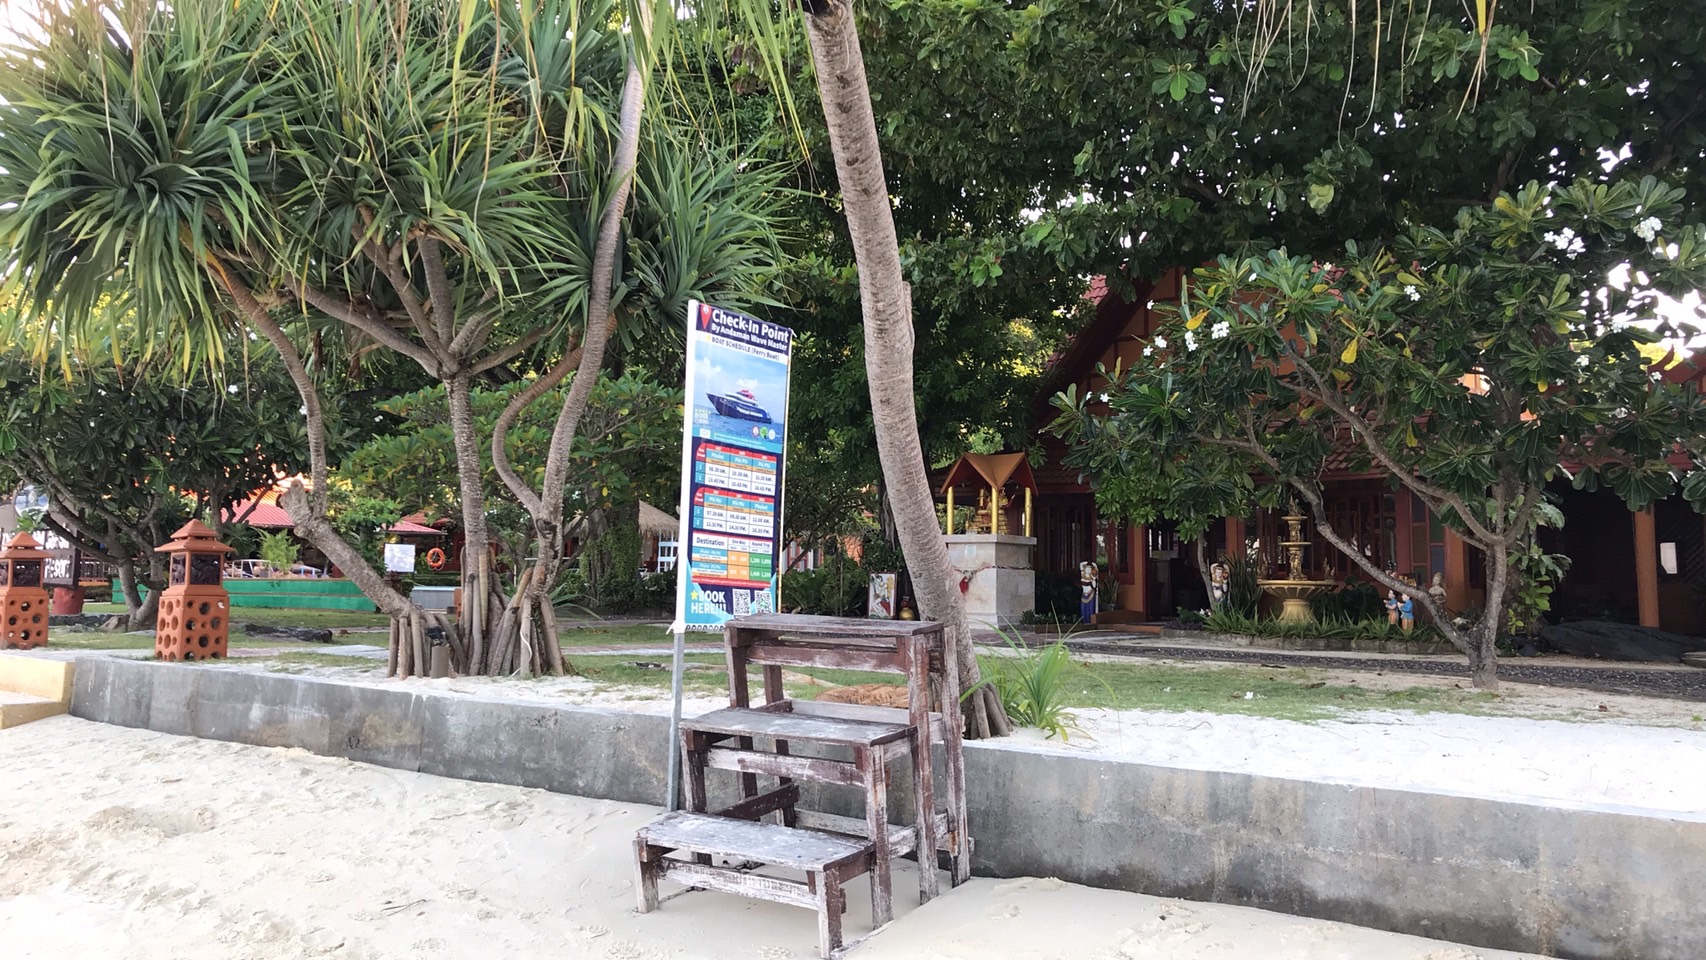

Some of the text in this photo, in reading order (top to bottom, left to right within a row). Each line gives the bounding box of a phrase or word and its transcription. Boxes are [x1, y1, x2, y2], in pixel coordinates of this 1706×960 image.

[712, 310, 788, 342] Check-In Point
[712, 323, 787, 351] By Andaman Wave Master
[726, 340, 750, 353] SCHEDULE
[766, 351, 779, 360] Boat)
[697, 537, 724, 546] Destination
[699, 590, 726, 603] BOOK
[691, 602, 726, 614] HERE!!!
